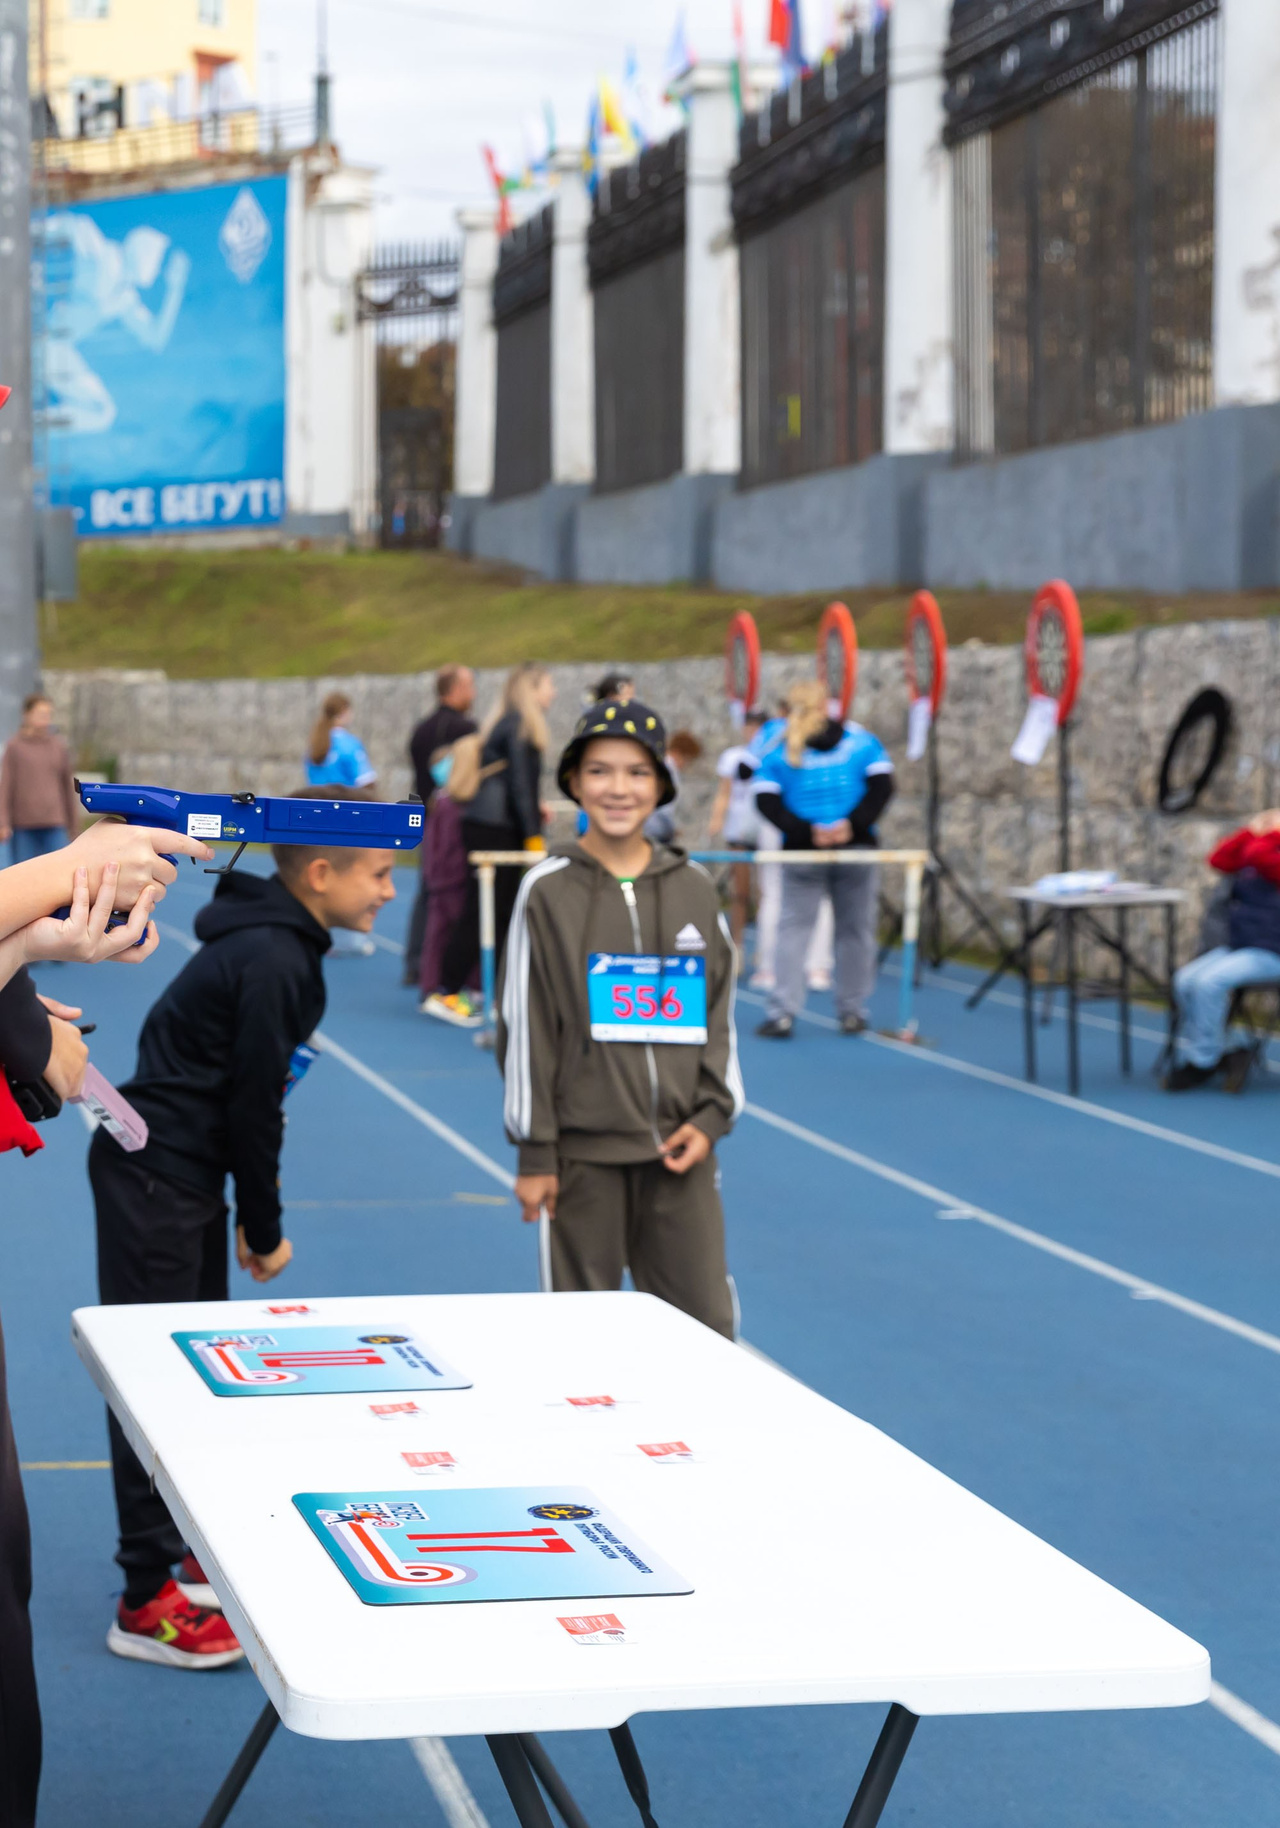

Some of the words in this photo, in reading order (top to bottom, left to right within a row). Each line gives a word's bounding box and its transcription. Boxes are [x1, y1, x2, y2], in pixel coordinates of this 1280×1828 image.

[91, 489, 154, 529] ВСЕ
[161, 479, 282, 525] БЕГУТ!
[612, 985, 683, 1019] 556
[257, 1348, 386, 1367] 10
[406, 1527, 576, 1552] 17
[573, 1523, 605, 1544] ПЯТИБОРЬЯ
[594, 1544, 621, 1559] РОССИИ
[588, 1522, 623, 1544] ФЕДЕРАЦИЯ
[613, 1545, 654, 1573] СОВРЕМЕННОГО
